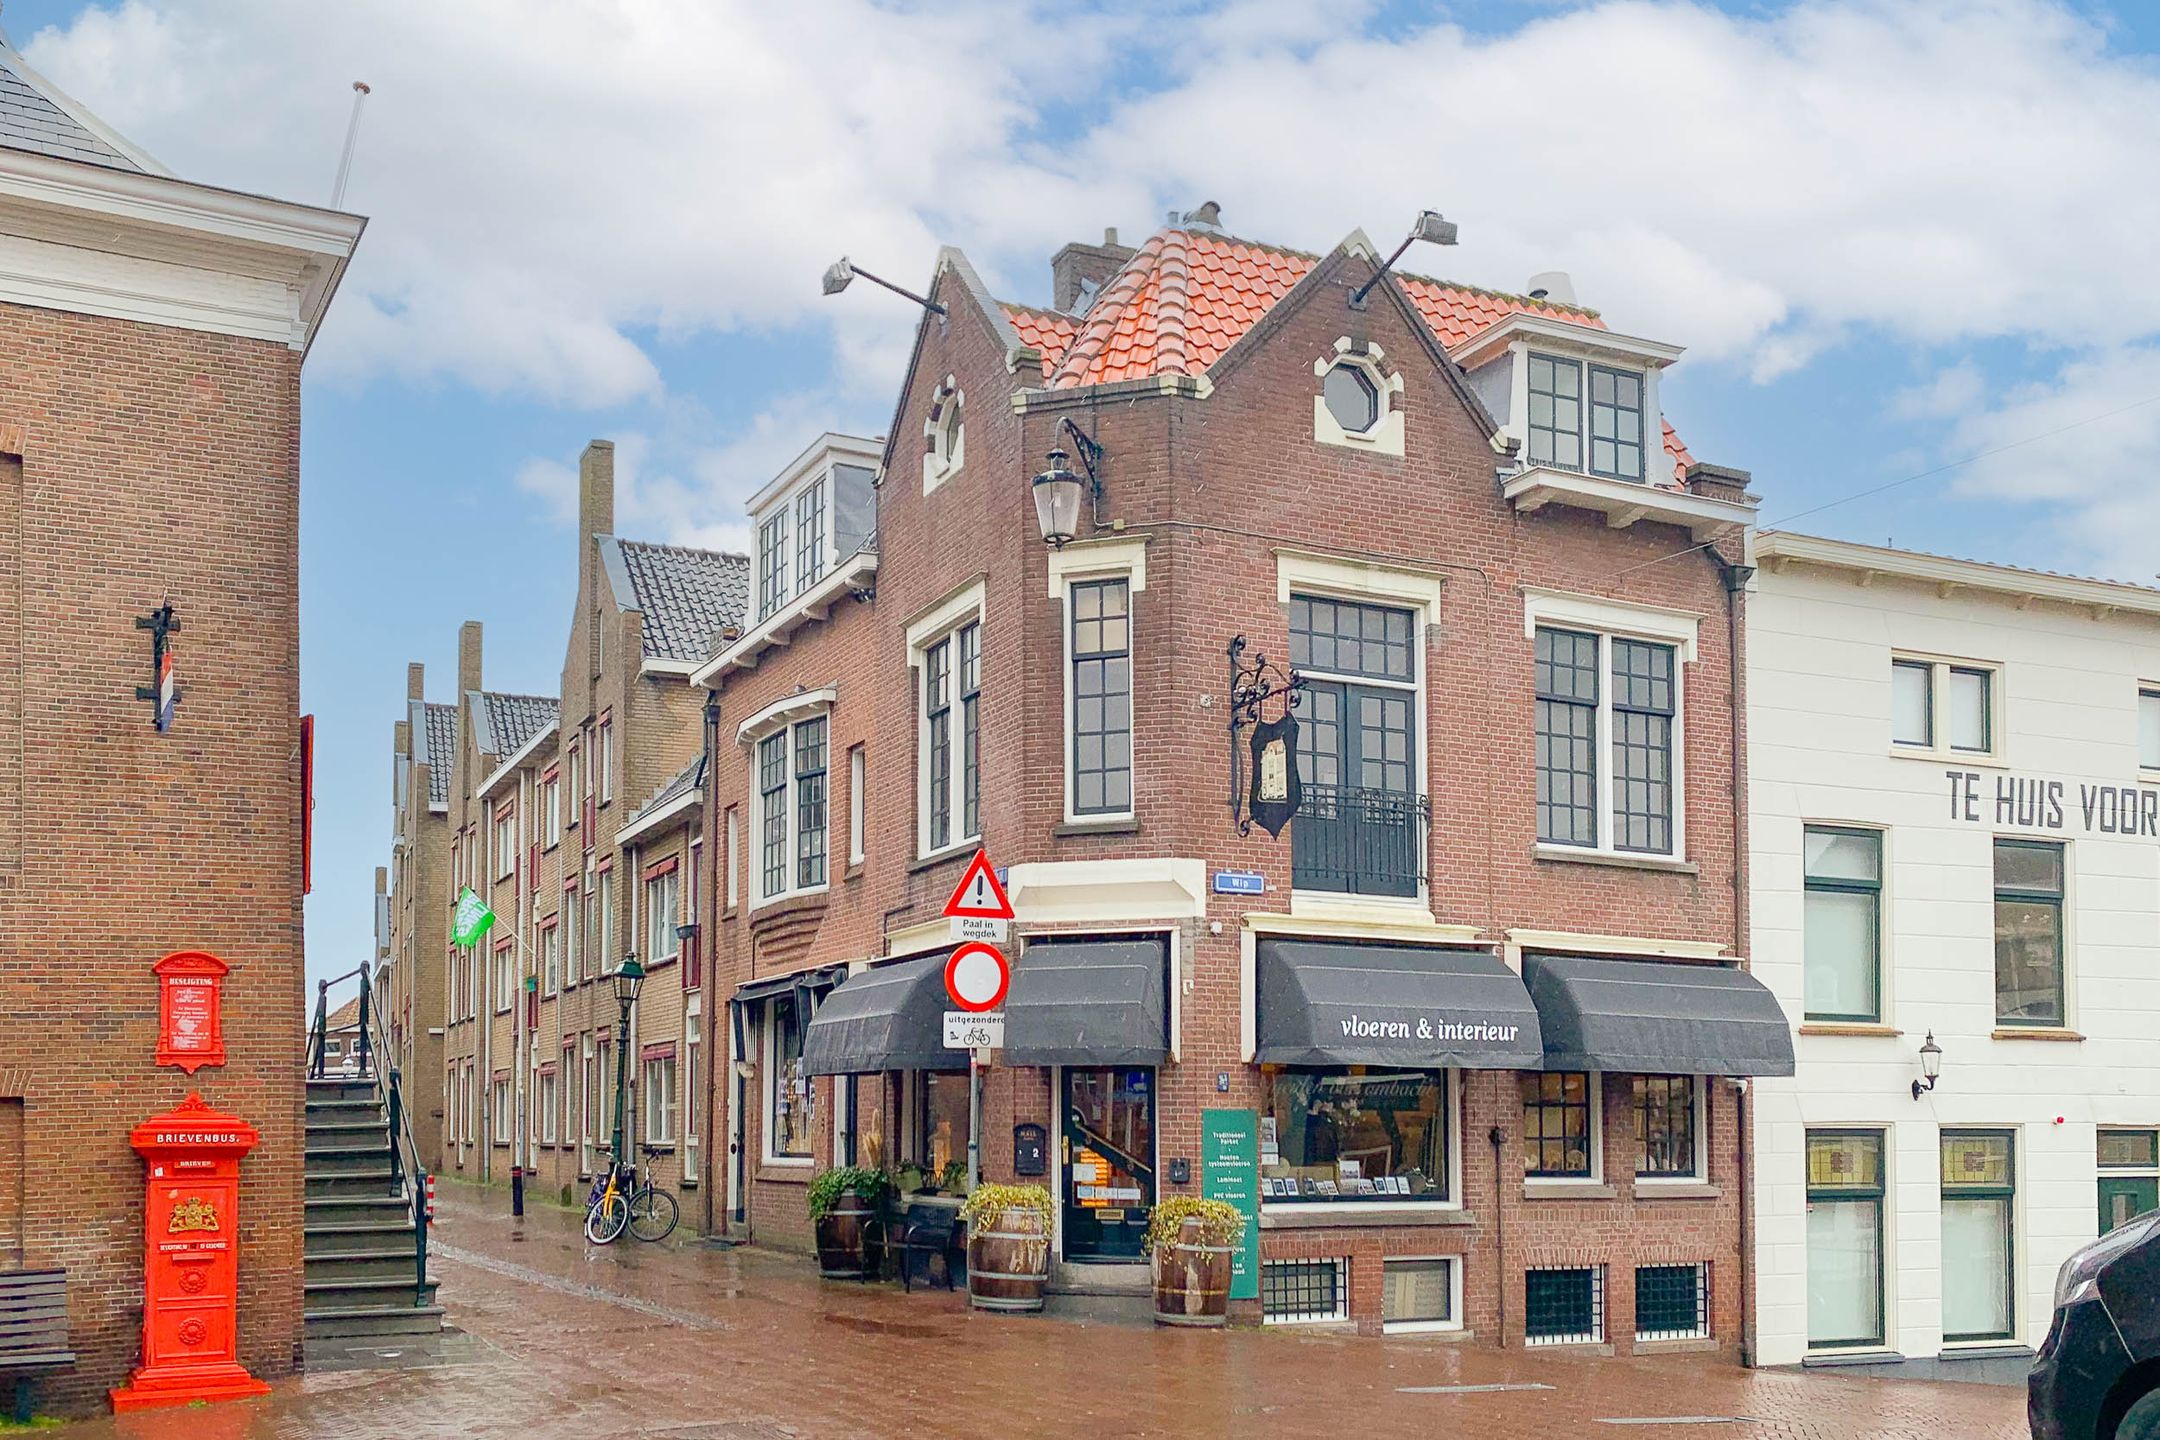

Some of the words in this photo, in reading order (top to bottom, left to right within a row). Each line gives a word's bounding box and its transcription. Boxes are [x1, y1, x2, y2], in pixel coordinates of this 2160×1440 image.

[1946, 771, 1980, 822] TE
[1996, 776, 2063, 829] HUIS
[2080, 784, 2157, 837] VOOR
[963, 920, 982, 928] Paal
[963, 929, 996, 938] wegdek
[1340, 1014, 1410, 1039] vloeren
[1416, 1017, 1433, 1039] &
[1438, 1018, 1519, 1042] interieur
[157, 1134, 240, 1143] BRIEVENBUS.
[1032, 1147, 1039, 1158] 2
